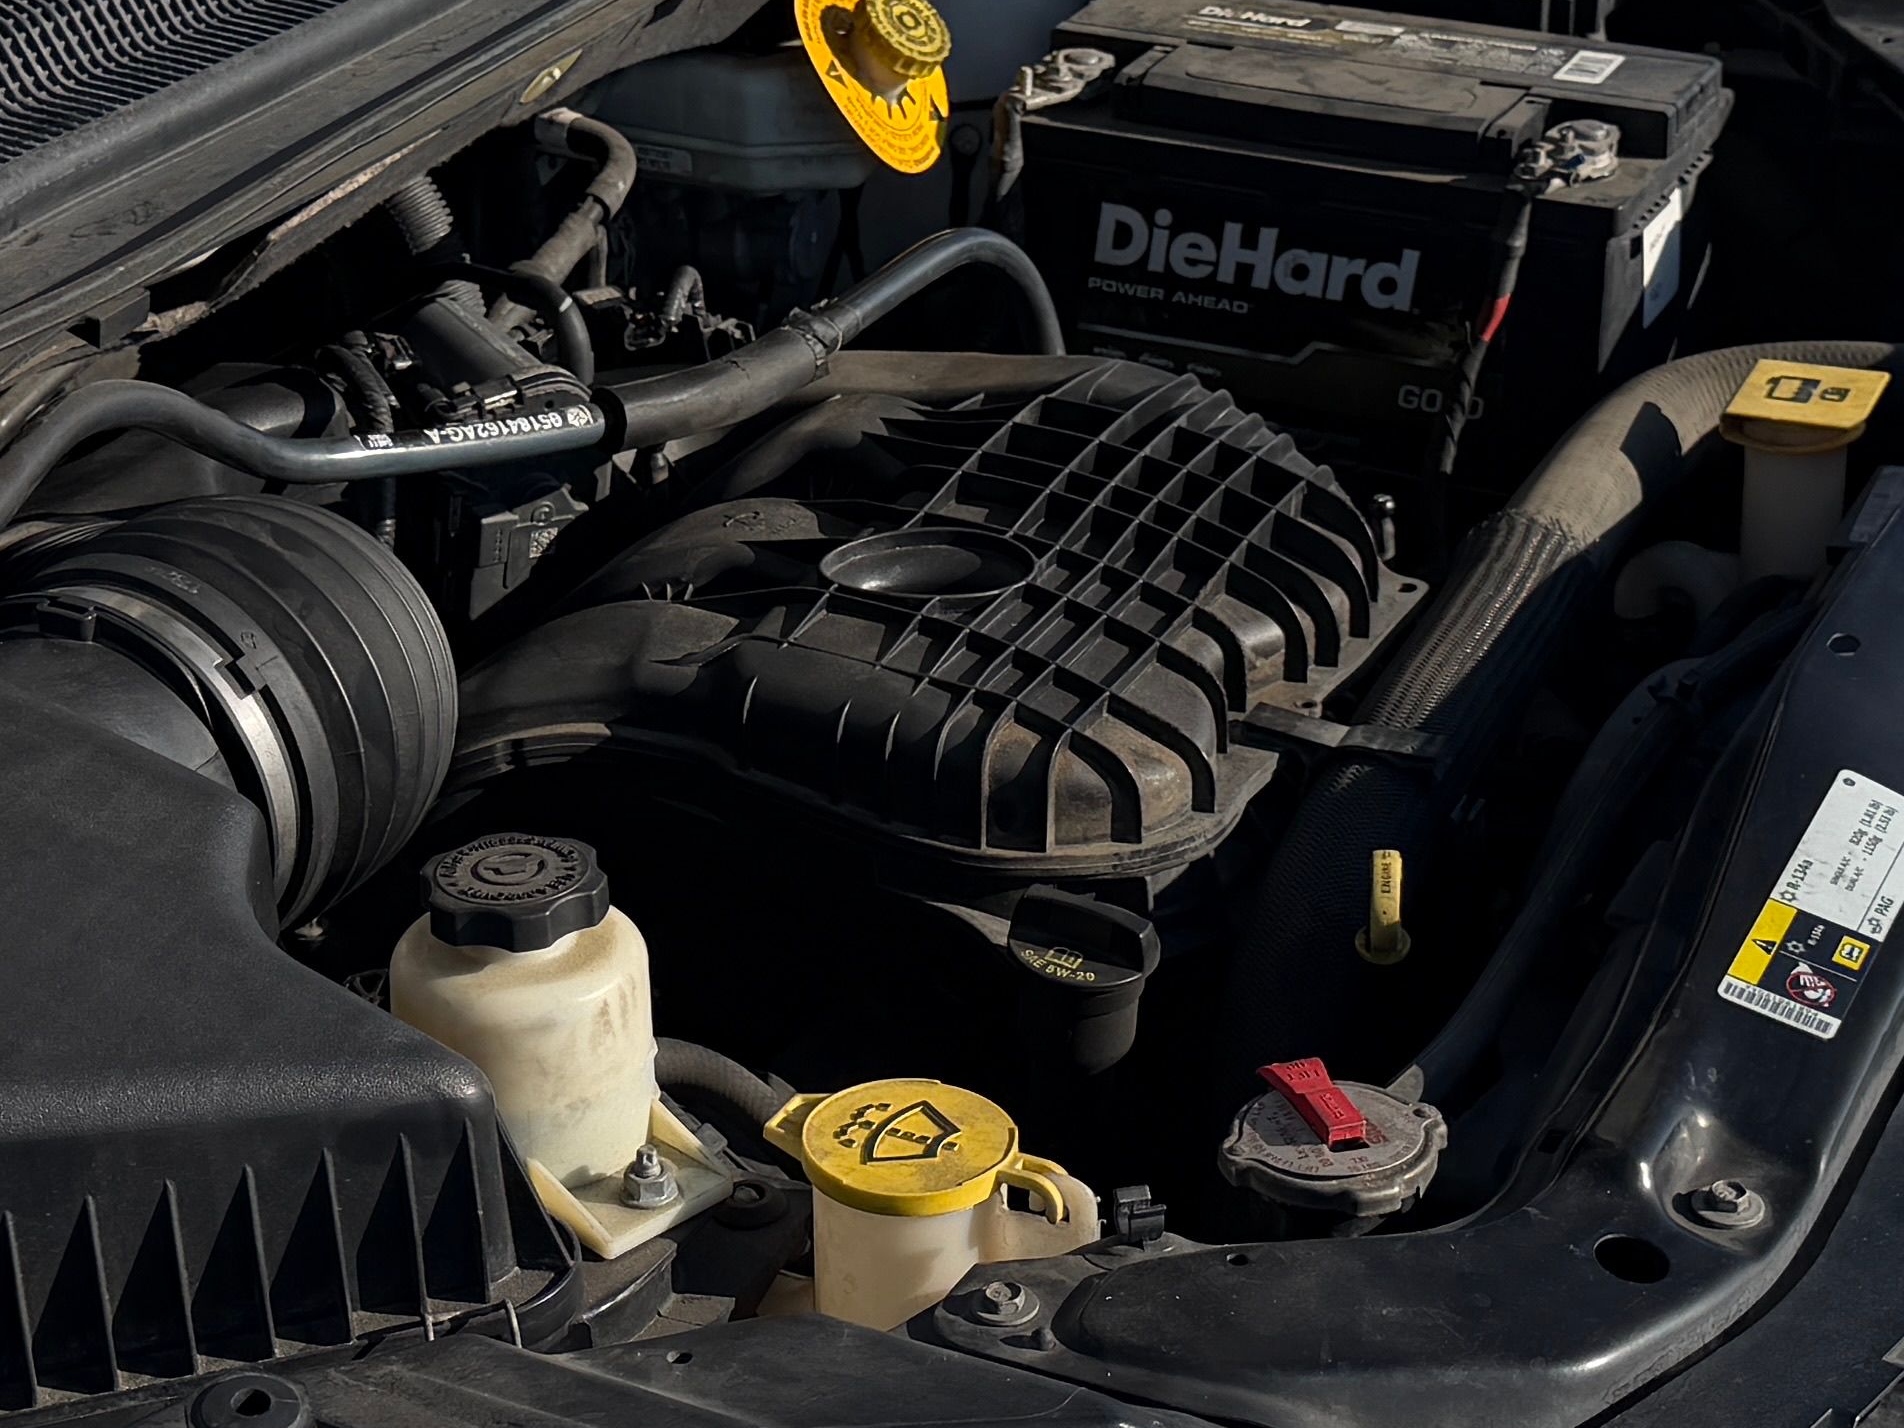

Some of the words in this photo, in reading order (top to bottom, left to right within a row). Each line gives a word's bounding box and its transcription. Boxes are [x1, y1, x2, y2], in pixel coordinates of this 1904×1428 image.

[1094, 201, 1422, 313] DieHard
[1087, 276, 1165, 302] POWER
[1172, 290, 1249, 315] AHEAD
[1398, 385, 1485, 420] GOD
[1863, 834, 1884, 857] 1150g
[1787, 859, 1815, 891] R-134a
[1874, 896, 1894, 917] PAG
[1021, 949, 1045, 968] SAE
[1045, 965, 1096, 981] 5W-20
